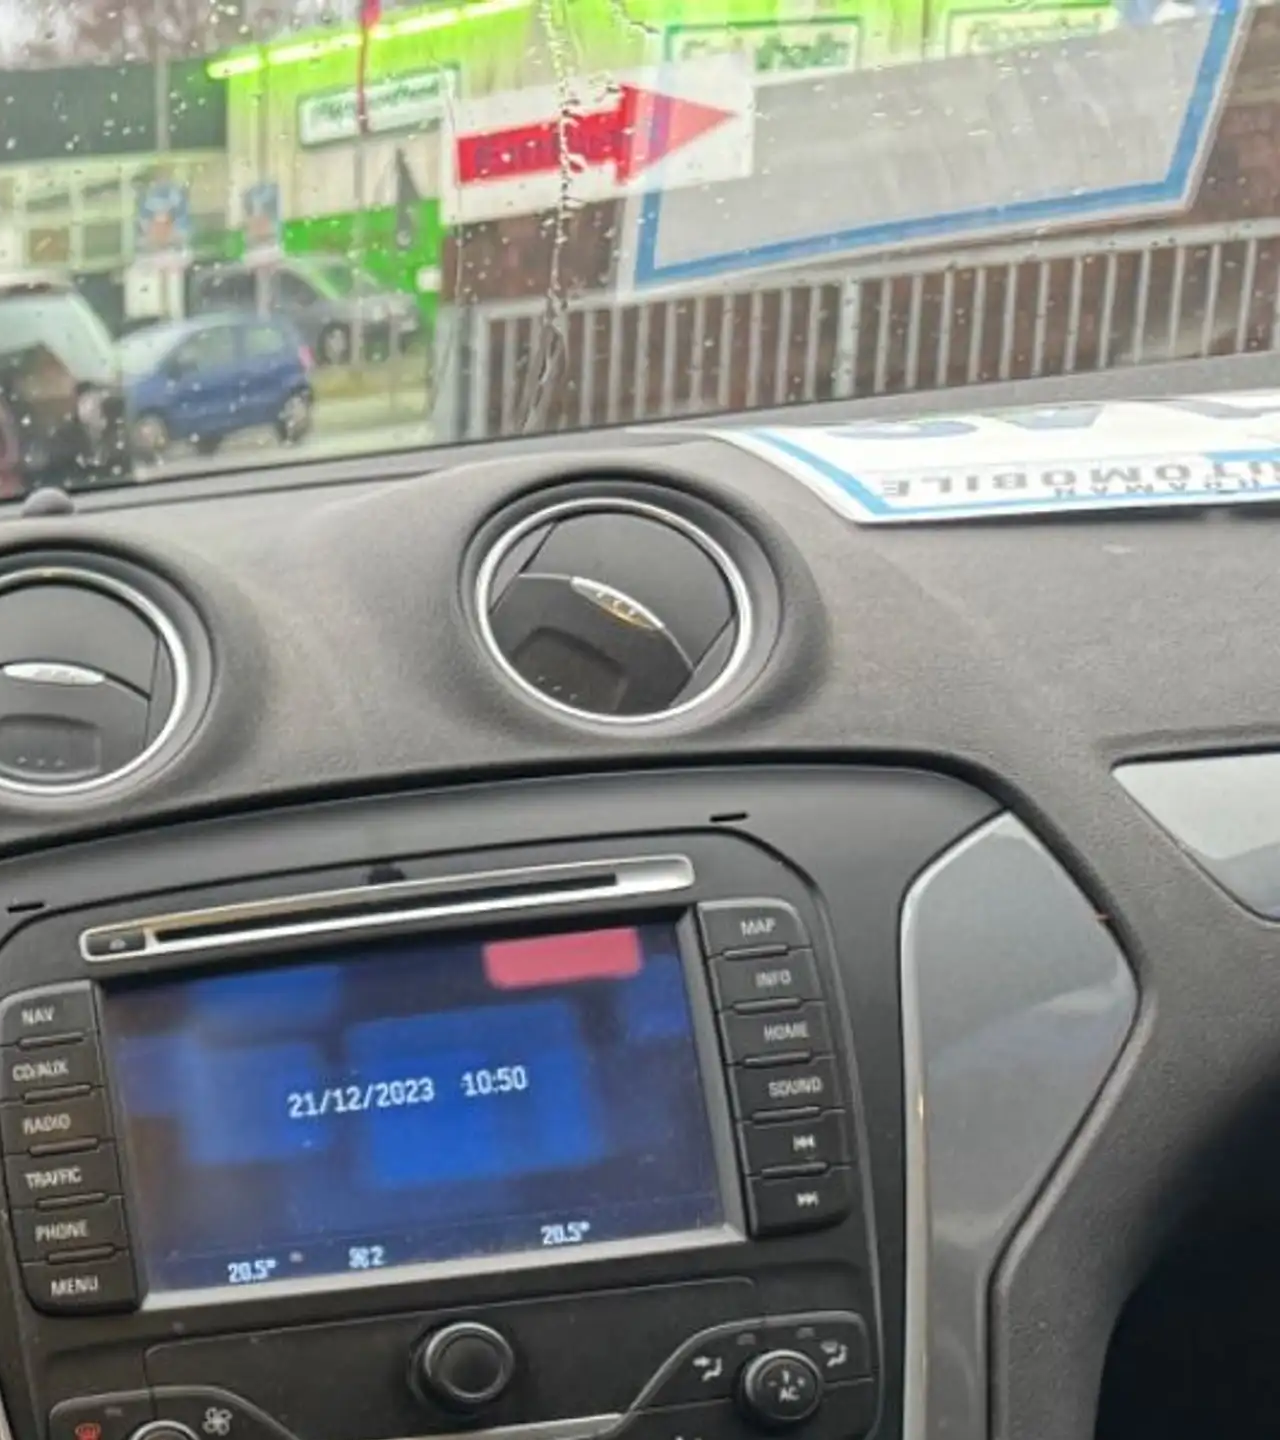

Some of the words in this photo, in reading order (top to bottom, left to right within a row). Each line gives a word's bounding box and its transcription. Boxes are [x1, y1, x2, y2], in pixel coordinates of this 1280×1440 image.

[740, 917, 776, 936] MAP
[755, 970, 791, 987] INFO
[21, 1006, 55, 1025] NAV
[763, 1020, 811, 1041] HOME
[287, 1076, 437, 1119] 21/12/2023
[460, 1064, 530, 1098] 10:50
[768, 1075, 824, 1098] SOUND
[22, 1112, 72, 1135] RADIO
[24, 1166, 83, 1190] TRAFFIC
[34, 1218, 88, 1242] PHONE
[50, 1275, 99, 1297] MENU
